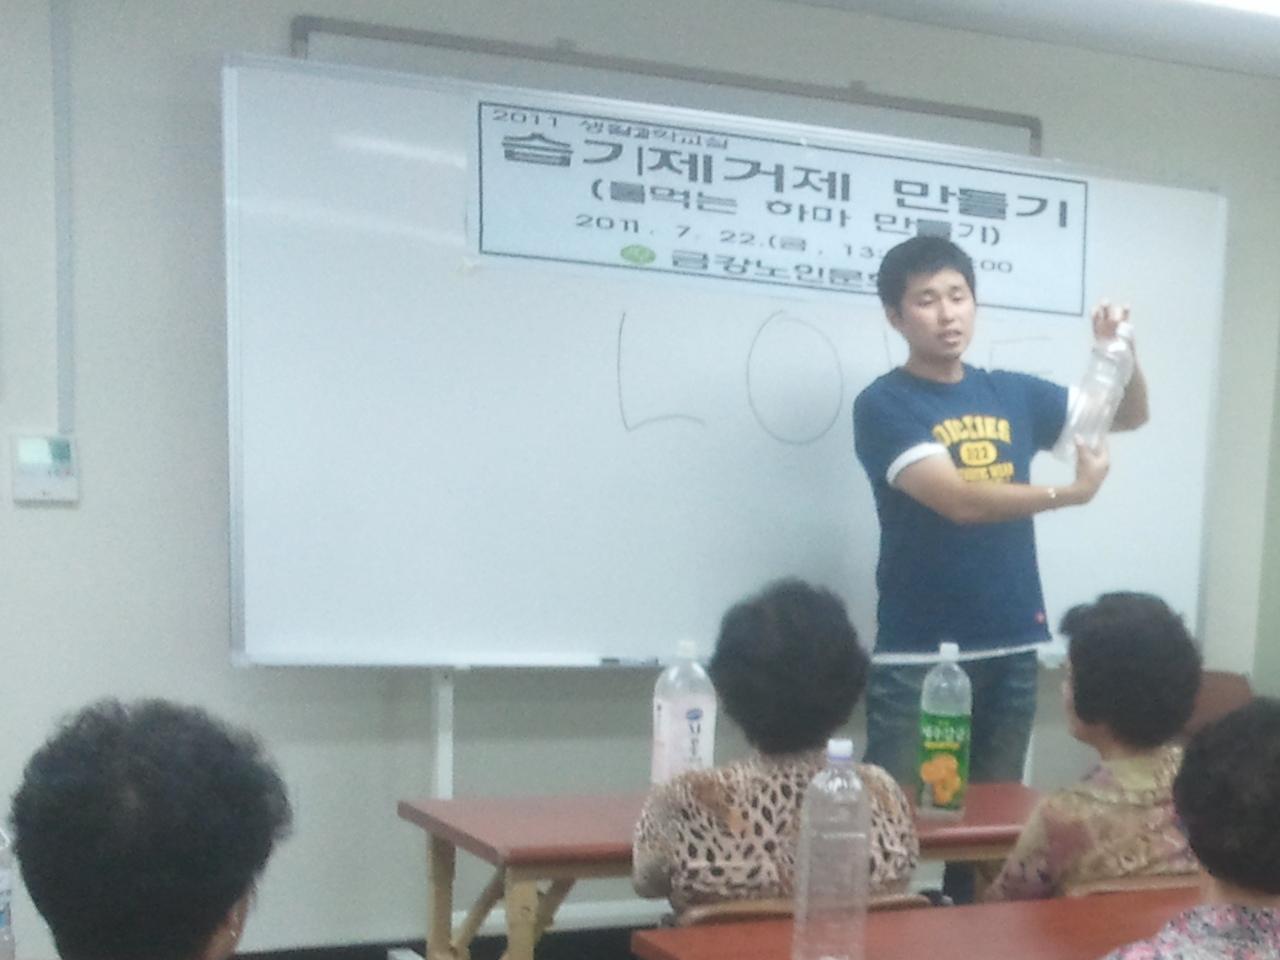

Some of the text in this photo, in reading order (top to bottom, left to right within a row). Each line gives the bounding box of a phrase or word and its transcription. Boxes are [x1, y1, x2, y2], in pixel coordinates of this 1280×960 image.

[492, 108, 558, 128] 2011
[502, 132, 1070, 228] 습기제거제 만들기
[766, 200, 851, 228] 하마
